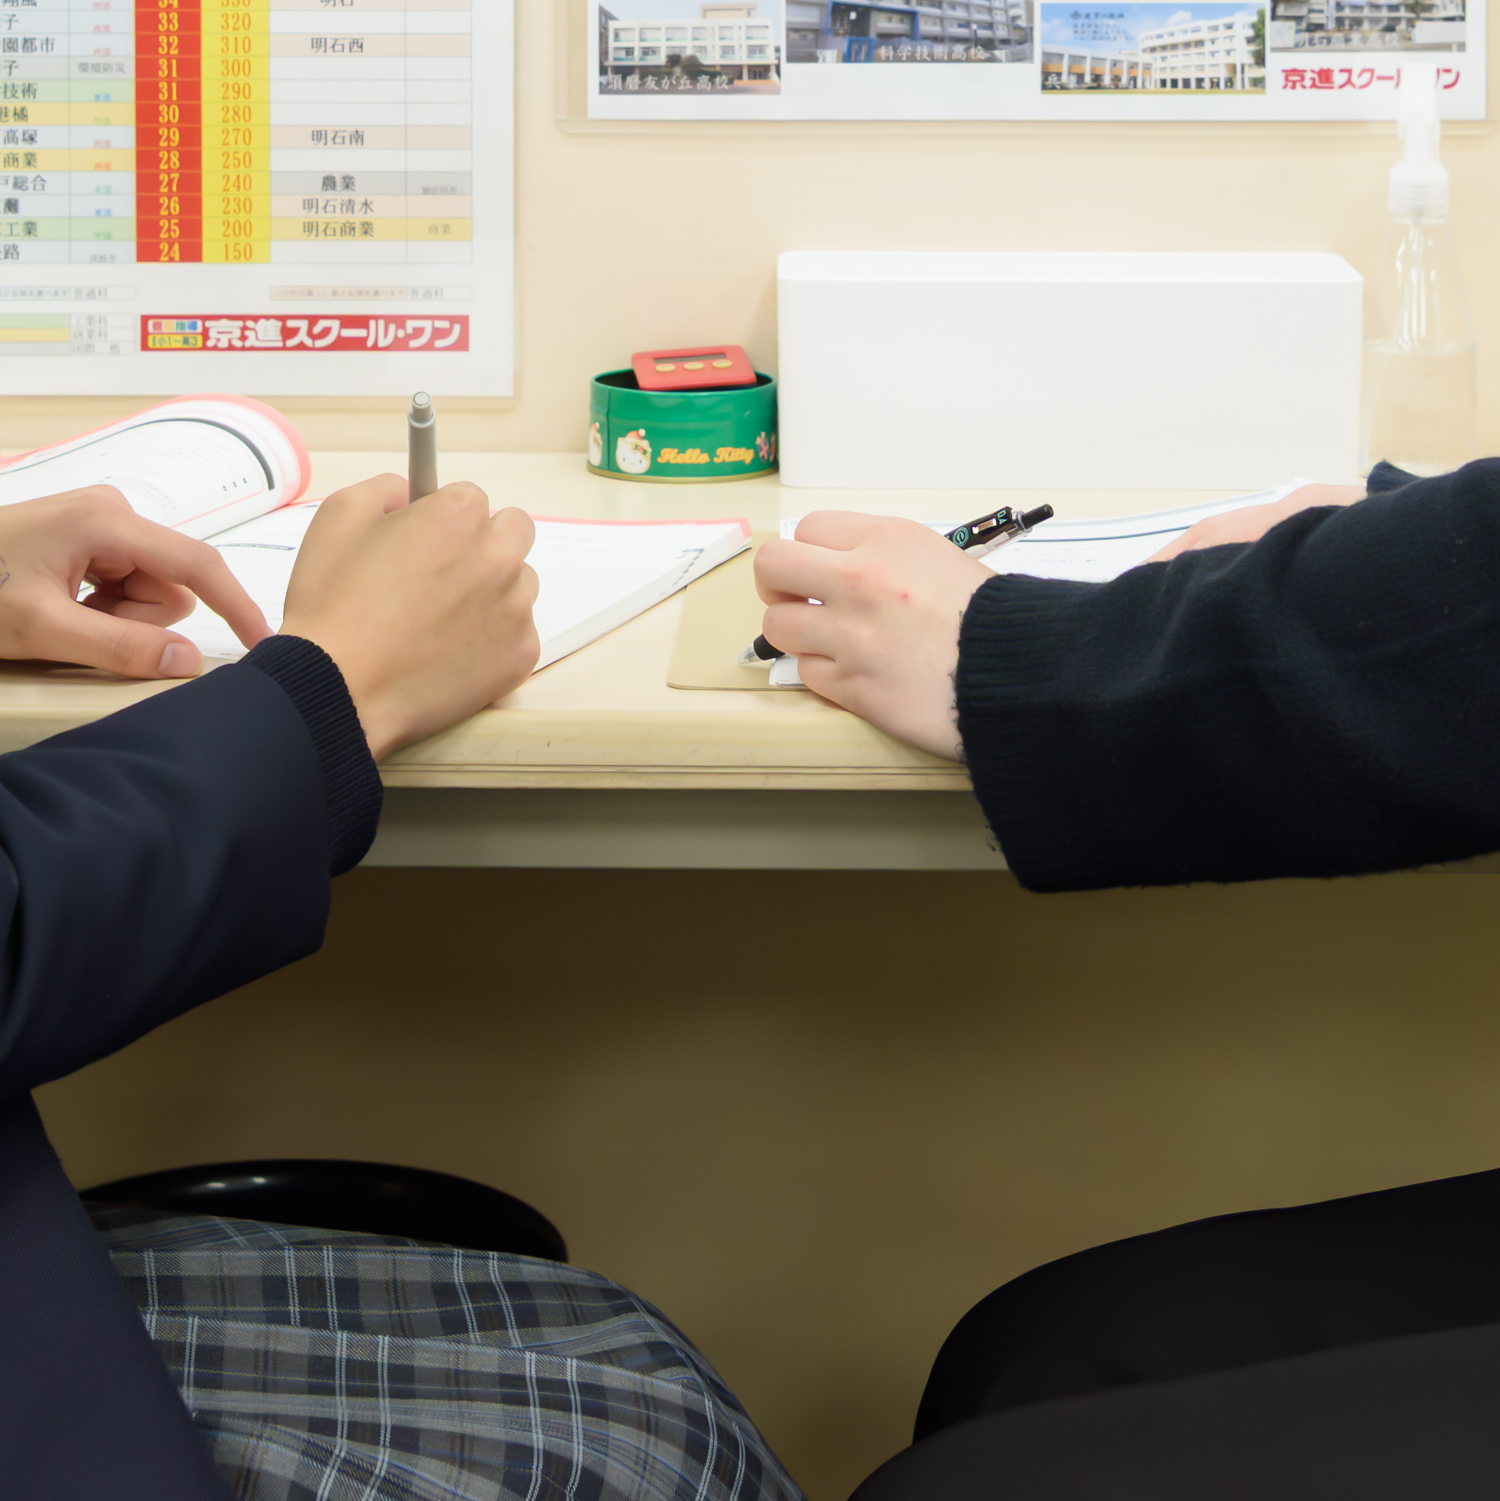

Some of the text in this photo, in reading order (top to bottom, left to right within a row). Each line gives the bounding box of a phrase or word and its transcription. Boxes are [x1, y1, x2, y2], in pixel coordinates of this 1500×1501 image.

[157, 12, 181, 31] 33
[221, 12, 253, 31] 320
[157, 35, 181, 54] 32
[221, 35, 253, 54] 310
[310, 36, 365, 54] 明石西
[157, 58, 181, 77] 31
[221, 58, 253, 77] 300
[157, 81, 181, 100] 31
[221, 81, 253, 100] 290
[157, 104, 181, 123] 30
[221, 104, 253, 123] 280
[157, 127, 181, 146] 29
[221, 127, 253, 146] 270
[310, 128, 365, 147] 明石南
[157, 150, 181, 169] 28
[221, 150, 253, 169] 250
[157, 173, 181, 192] 27
[221, 173, 253, 192] 240
[157, 196, 181, 215] 26
[221, 196, 253, 215] 230
[302, 197, 375, 216] 明石清水
[157, 219, 181, 238] 25
[221, 219, 253, 238] 200
[302, 220, 374, 239] 明石商業
[157, 242, 181, 262] 24
[224, 242, 253, 262] 150
[657, 448, 710, 464] Hello
